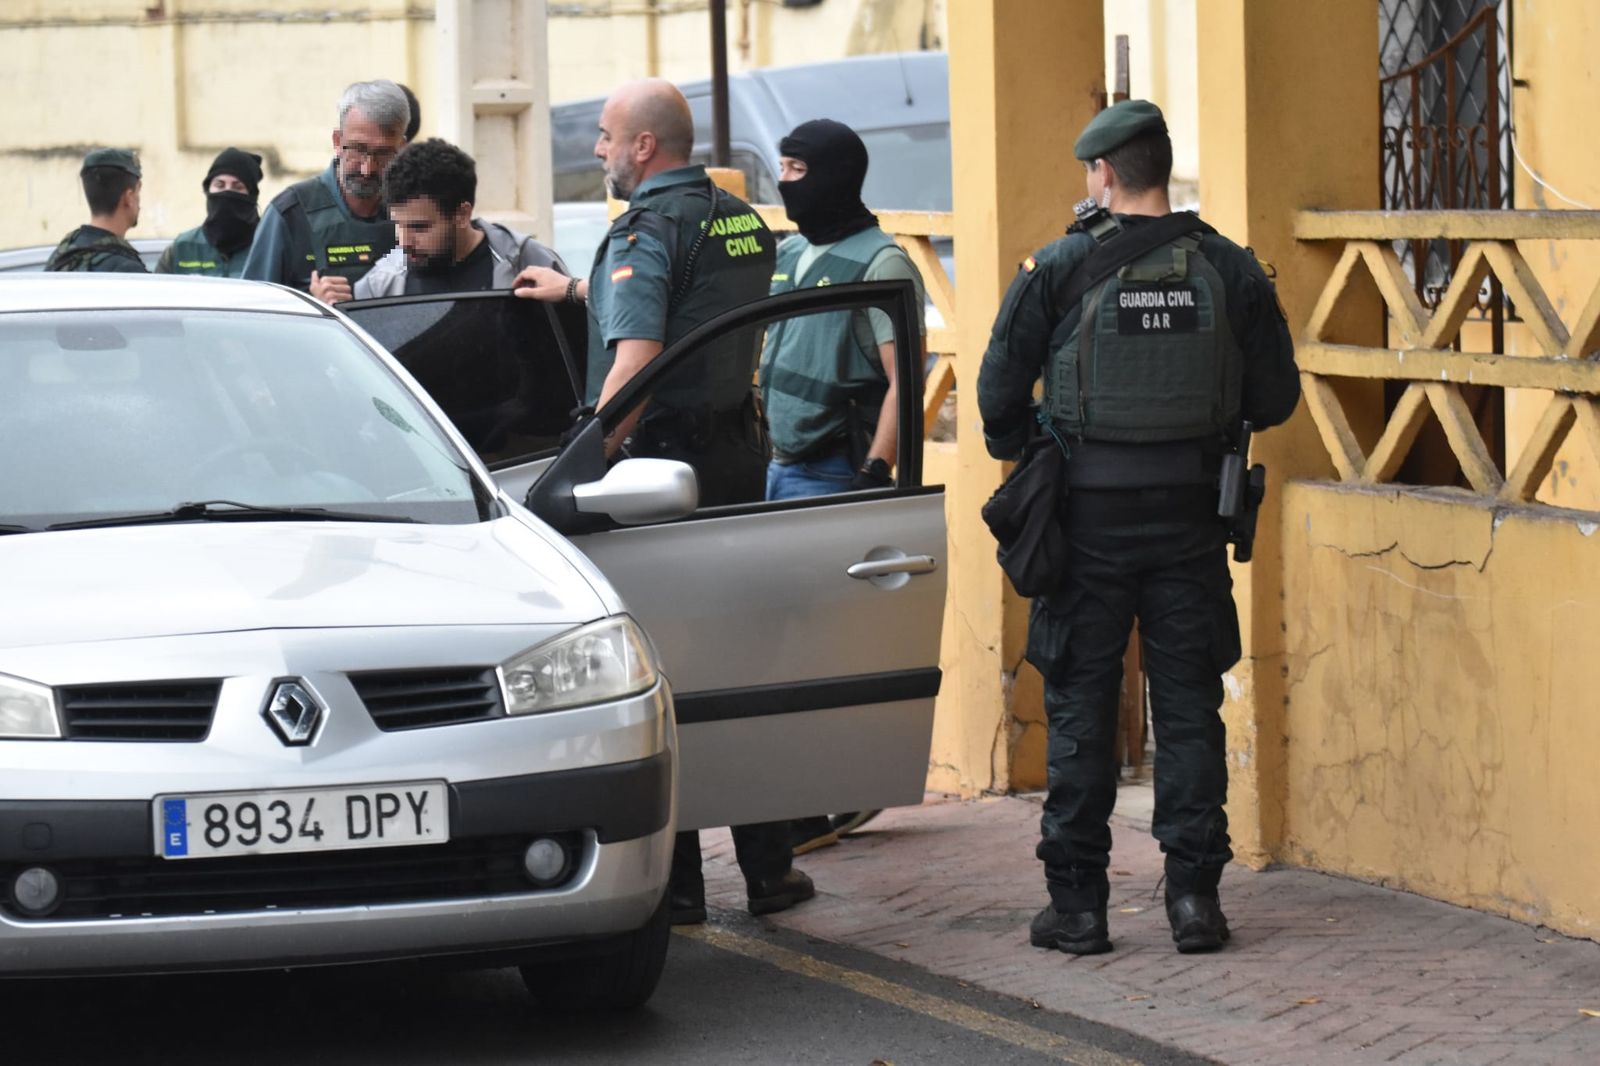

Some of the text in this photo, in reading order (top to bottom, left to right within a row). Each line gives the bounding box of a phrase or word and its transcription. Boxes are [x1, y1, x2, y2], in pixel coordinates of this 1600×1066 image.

[726, 235, 763, 257] CIVIL
[1119, 290, 1195, 308] GUARDIA CIVIL
[204, 790, 429, 848] 8934 DPY
[170, 833, 182, 846] E
